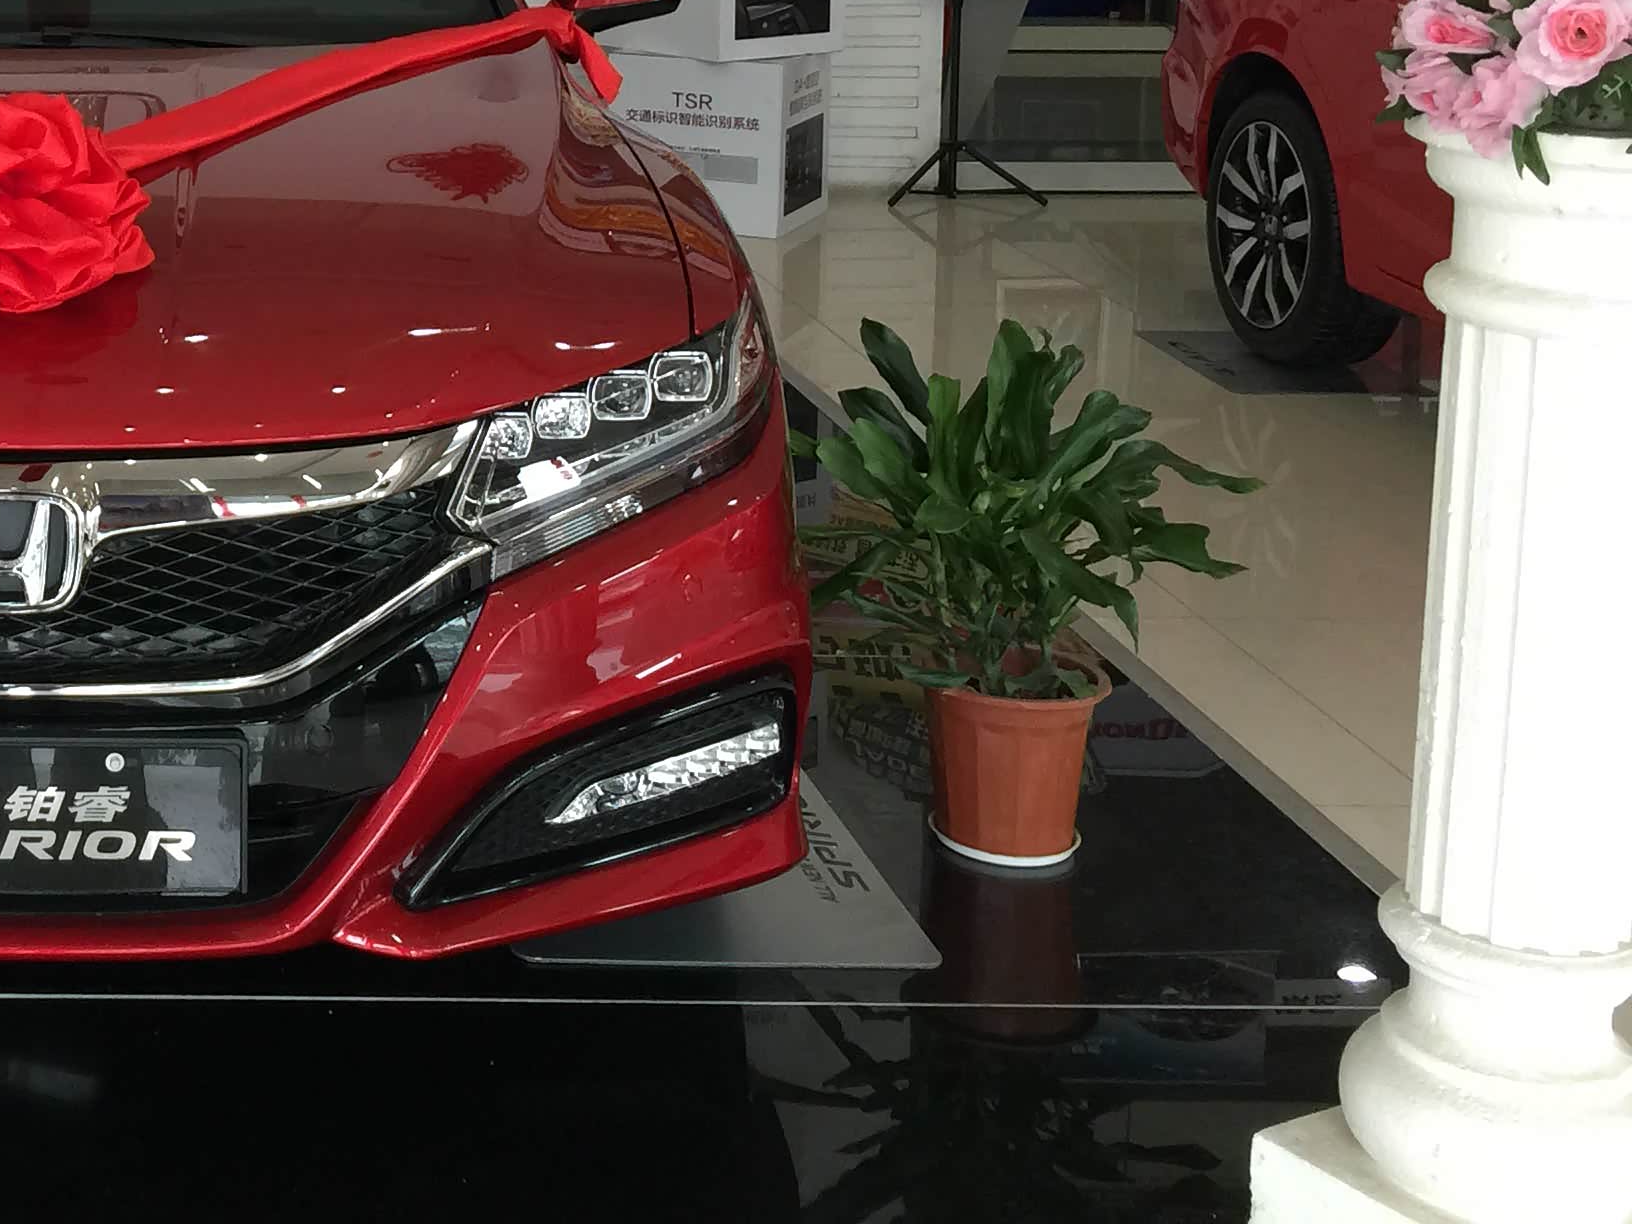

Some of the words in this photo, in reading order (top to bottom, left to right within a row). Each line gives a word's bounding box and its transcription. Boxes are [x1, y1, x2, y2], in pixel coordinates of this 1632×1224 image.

[672, 91, 713, 110] TSR
[625, 108, 760, 132] 交通标识智能识别系统
